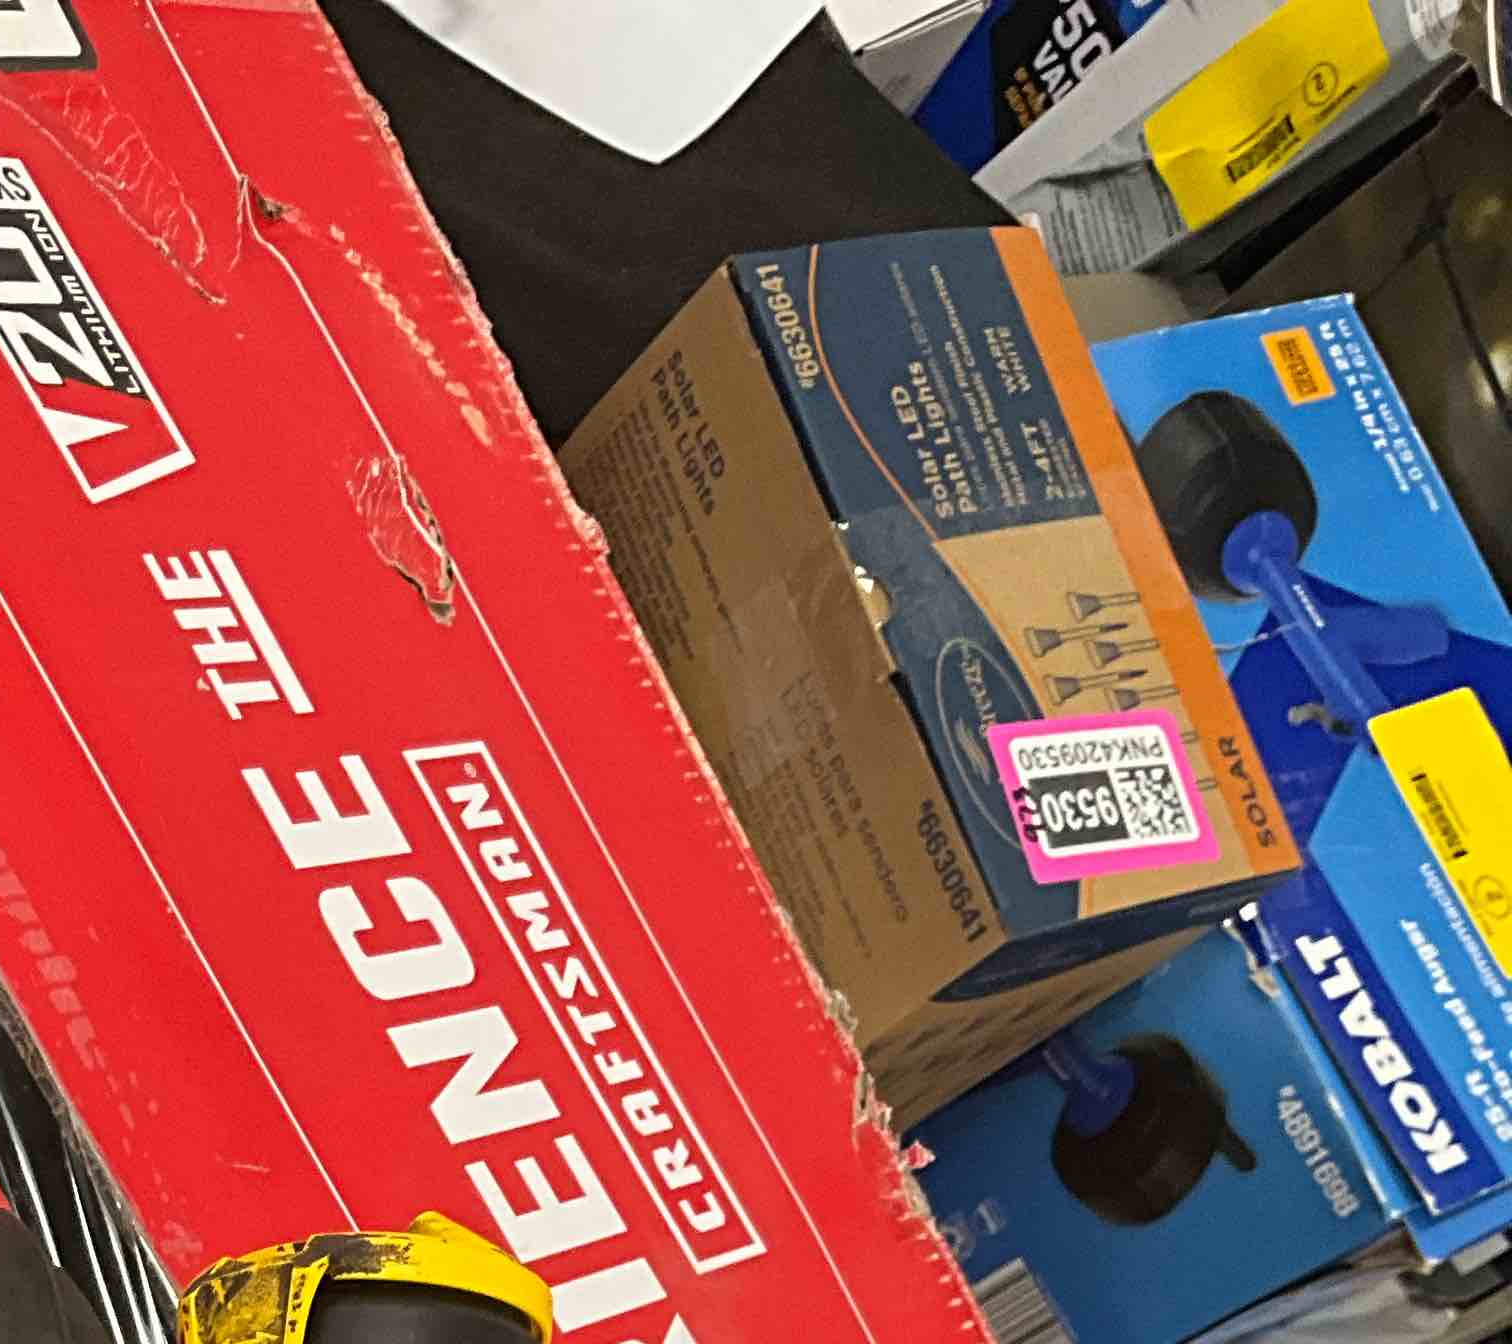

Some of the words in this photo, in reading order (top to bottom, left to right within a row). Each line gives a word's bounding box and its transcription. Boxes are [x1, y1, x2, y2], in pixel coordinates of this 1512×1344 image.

[1052, 0, 1113, 81] 50
[23, 205, 67, 265] ION
[60, 269, 142, 398] LITHIUM
[757, 264, 819, 388] #6630641
[982, 327, 1018, 393] WARM
[996, 323, 1033, 392] WHITE
[646, 365, 687, 432] Path
[669, 430, 721, 518] Lights
[663, 349, 705, 419] Solar
[690, 420, 730, 482] LED
[887, 381, 925, 443] LED
[904, 356, 955, 448] Lights
[913, 443, 956, 521] Solar
[939, 448, 979, 516] Path
[141, 547, 280, 722] THE
[1016, 734, 1163, 770] PNK4209530
[1215, 735, 1276, 848] SOLAR
[1039, 785, 1120, 833] 9530
[913, 798, 989, 944] #6630641
[1398, 919, 1455, 997] Auger
[442, 778, 730, 1234] CRAFTSMAN
[1294, 930, 1469, 1175] KOBALT
